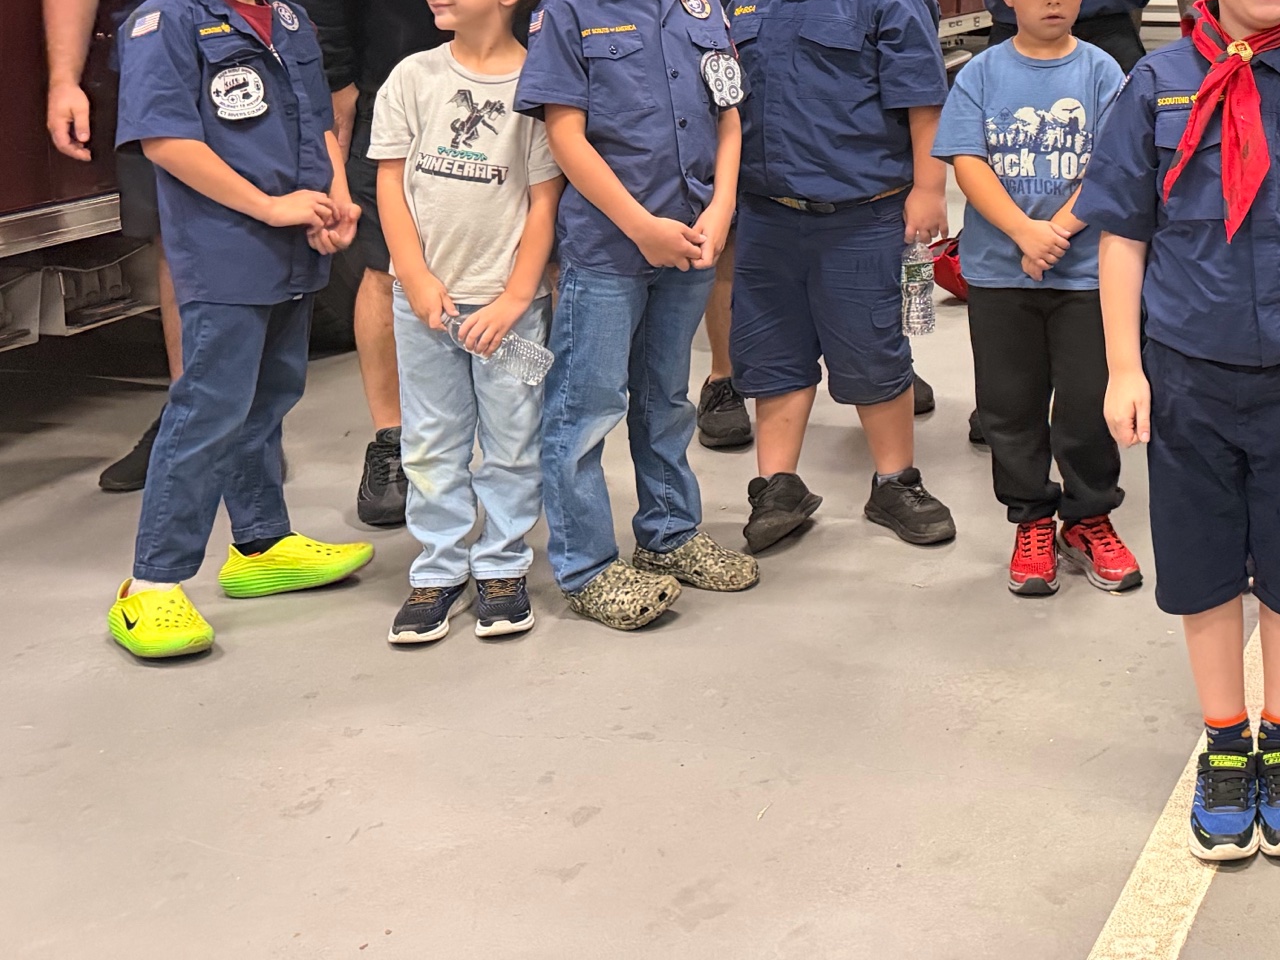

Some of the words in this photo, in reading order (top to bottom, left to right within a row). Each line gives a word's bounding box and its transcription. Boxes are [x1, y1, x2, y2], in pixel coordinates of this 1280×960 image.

[615, 24, 637, 33] AMERICA
[1157, 96, 1190, 106] SCOUTING
[990, 148, 1036, 178] ack
[415, 152, 509, 185] MINECRAFT
[1208, 754, 1248, 763] SKECHERS
